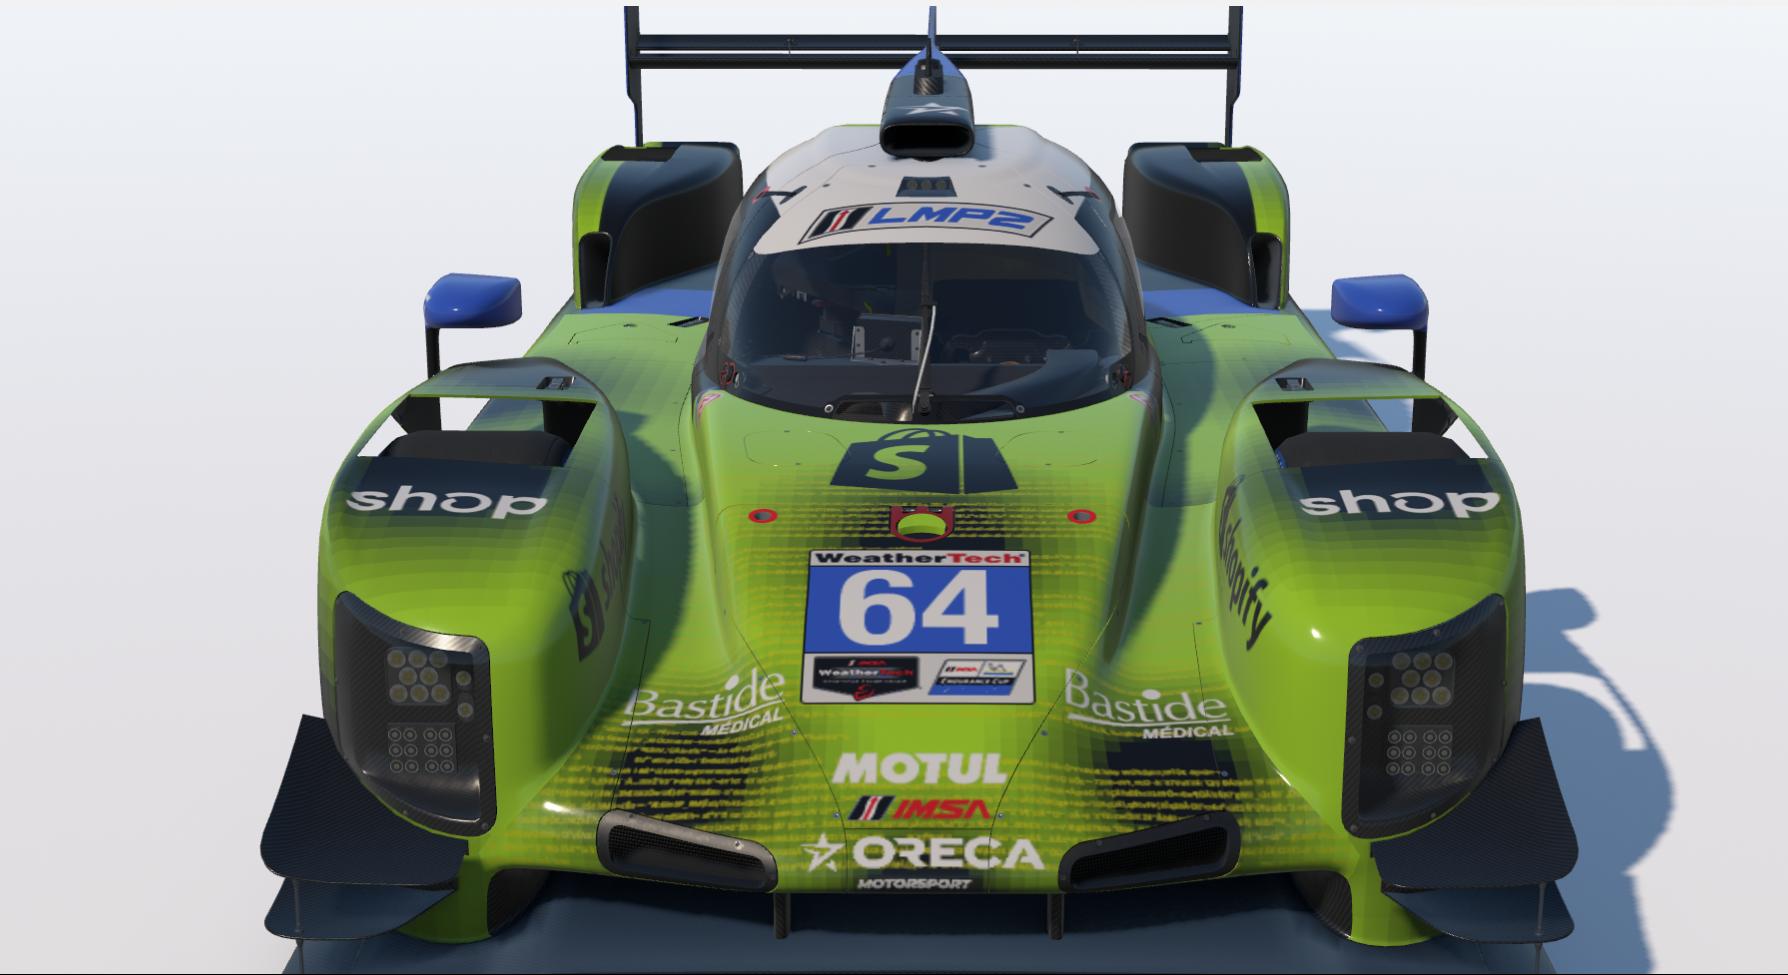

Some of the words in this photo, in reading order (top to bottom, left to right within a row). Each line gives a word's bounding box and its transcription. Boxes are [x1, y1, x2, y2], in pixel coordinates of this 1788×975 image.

[868, 206, 1035, 230] LMP2
[346, 485, 548, 519] shop
[1299, 489, 1500, 518] shop
[815, 552, 1022, 564] WeatherTech
[839, 569, 999, 646] 64
[624, 667, 785, 719] Bastide
[1065, 667, 1228, 723] Bastide
[1142, 724, 1235, 740] MÉDICAL
[832, 752, 1008, 784] MOTUL
[892, 799, 991, 820] IMSA
[853, 836, 1046, 870] ORECA
[857, 879, 973, 890] MOTORSPORT
